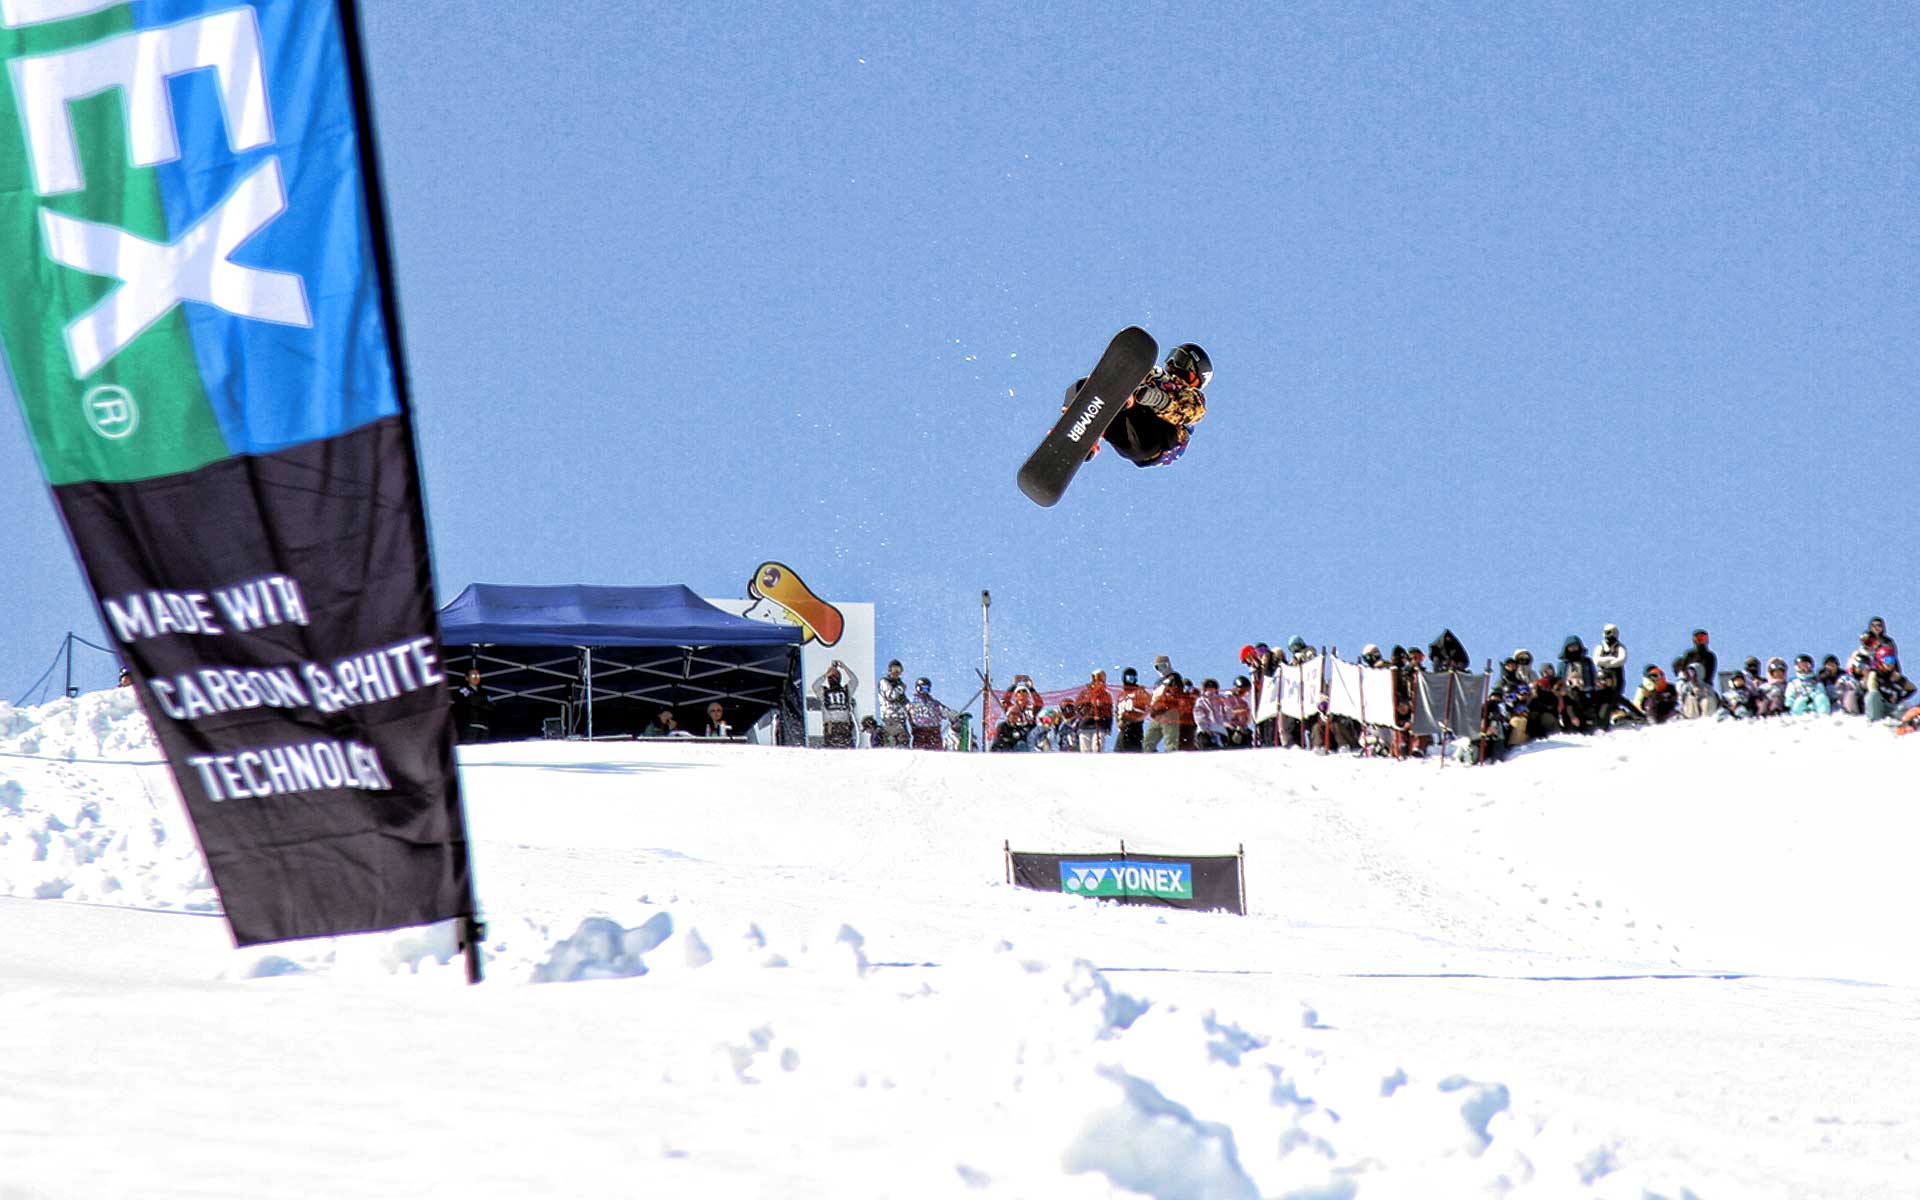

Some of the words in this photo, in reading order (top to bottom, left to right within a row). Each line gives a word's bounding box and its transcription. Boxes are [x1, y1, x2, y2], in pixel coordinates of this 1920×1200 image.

[3, 0, 313, 380] EX
[105, 591, 223, 642] MADE
[214, 576, 309, 632] WITH
[149, 667, 310, 720] CARBON
[1110, 867, 1185, 892] YONEX
